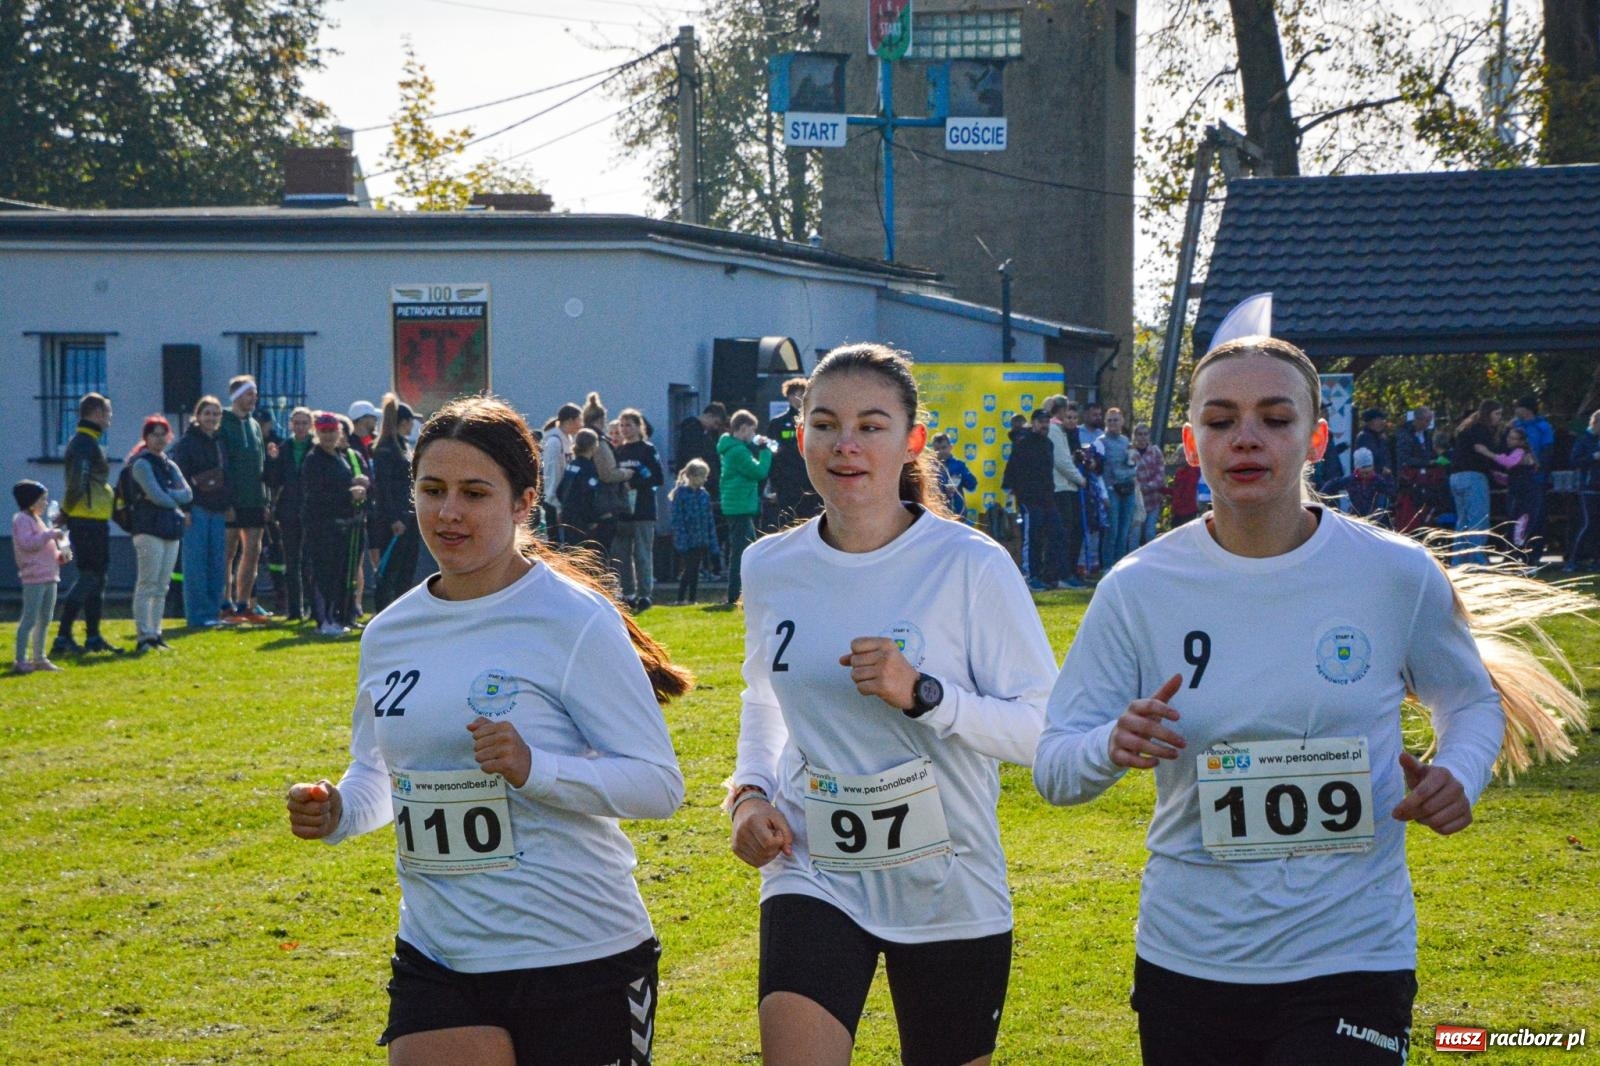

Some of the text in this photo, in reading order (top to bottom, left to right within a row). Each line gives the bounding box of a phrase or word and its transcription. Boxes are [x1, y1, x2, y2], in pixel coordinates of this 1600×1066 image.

[790, 121, 839, 141] START
[949, 122, 1005, 145] GOŚCIE
[428, 286, 452, 302] 100
[396, 304, 484, 317] PIETROWICE WIELKIE
[772, 619, 796, 672] 2
[1183, 630, 1212, 689] 9
[374, 669, 421, 717] 22
[1258, 749, 1363, 765] www.personalbest.pl
[415, 780, 498, 793] www.personalbest.pl
[843, 769, 928, 795] www.personalbest.pl
[1214, 780, 1363, 838] 109
[397, 805, 502, 855] 110
[830, 803, 910, 854] 97
[1335, 1017, 1400, 1053] hummel
